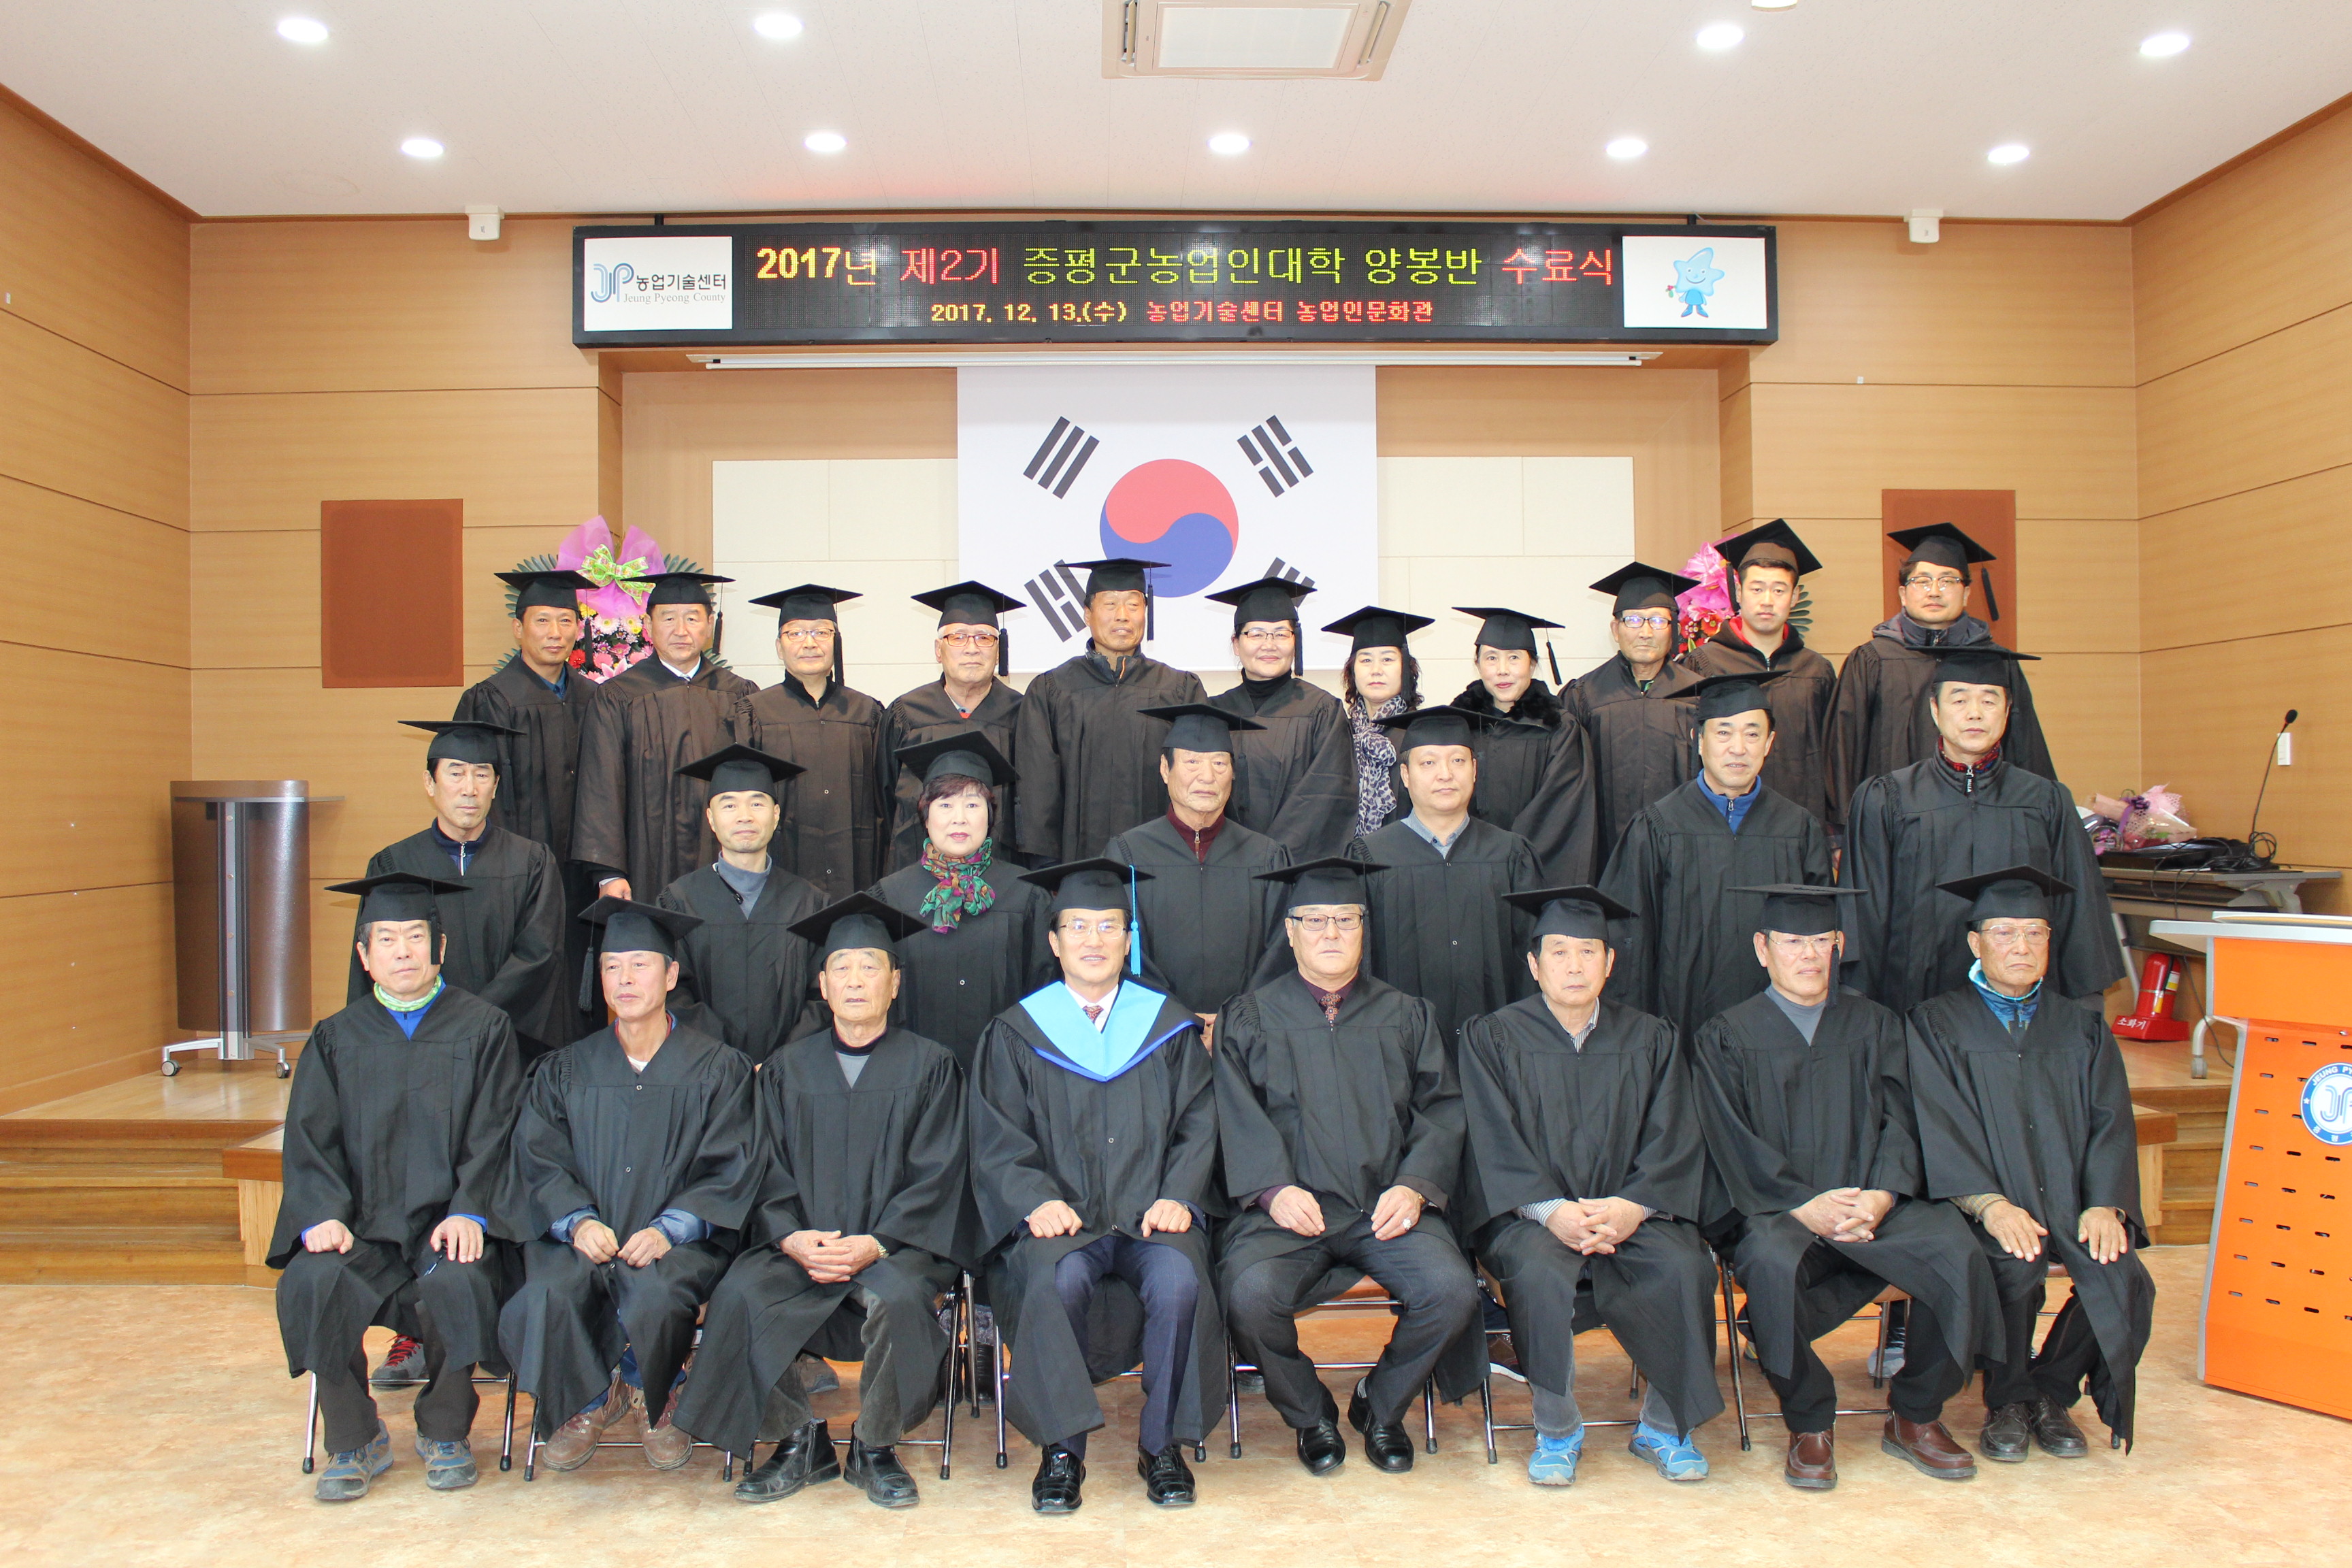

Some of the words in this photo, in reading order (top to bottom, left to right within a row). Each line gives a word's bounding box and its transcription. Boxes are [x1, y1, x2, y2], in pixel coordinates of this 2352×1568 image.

[757, 246, 877, 287] 2017년
[900, 247, 999, 285] 제2기
[1023, 247, 1346, 284] 증평군농업인대학
[1365, 247, 1483, 285] 양봉반
[1501, 247, 1613, 286] 수료식
[636, 274, 726, 291] 농업기술센터
[623, 293, 651, 304] Jeung
[654, 293, 689, 304] Pyeong
[693, 292, 726, 304] County
[930, 303, 992, 323] 2017.
[1004, 303, 1037, 323] 12.
[1146, 300, 1283, 323] 농업기술센터
[1296, 300, 1434, 323] 농업인문화관
[2117, 1017, 2146, 1030] 소화기
[2312, 1066, 2338, 1086] JEUNG
